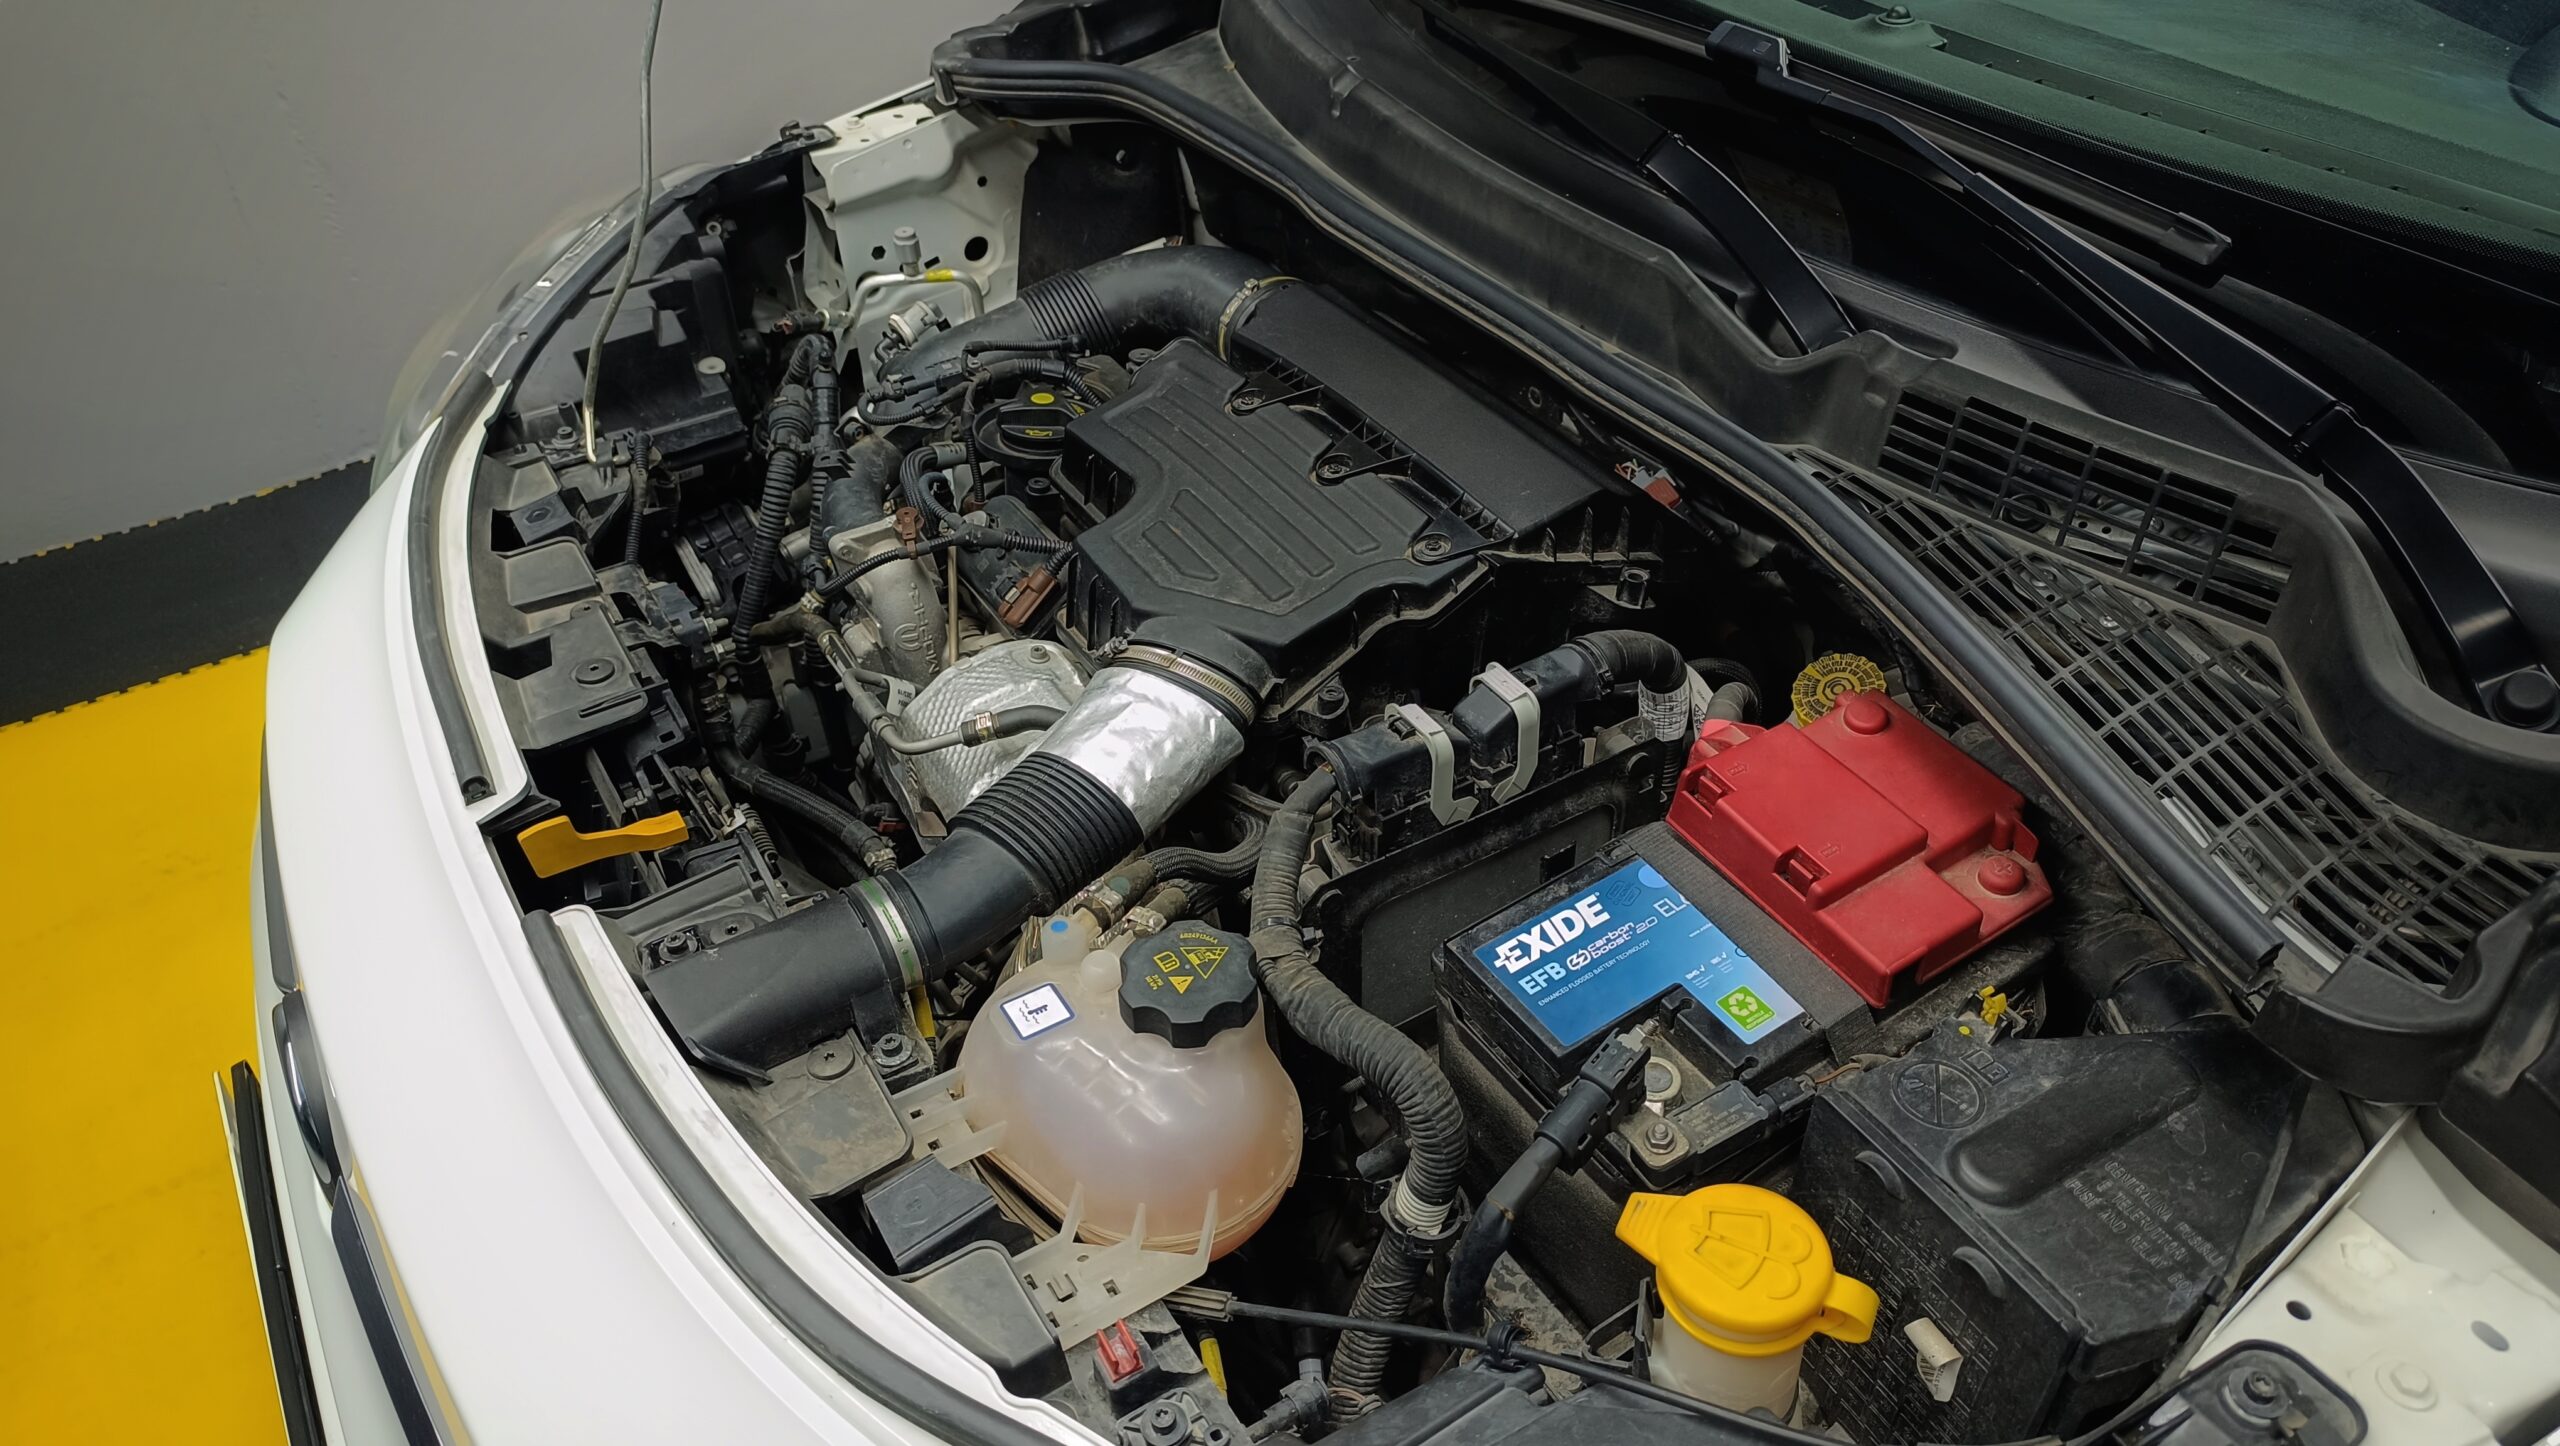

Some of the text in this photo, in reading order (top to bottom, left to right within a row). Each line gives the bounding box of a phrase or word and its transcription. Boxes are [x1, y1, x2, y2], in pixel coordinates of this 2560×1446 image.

[1652, 893, 1691, 917] EL
[1493, 894, 1611, 974] EXIDE
[1587, 922, 1635, 951] carbon
[1591, 933, 1632, 959] boost
[1518, 962, 1567, 996] EFB
[1538, 939, 1651, 1007] ENHANCED FLOODED BATTERY TECHNOLOGY
[2104, 1161, 2175, 1222] CENTRALINA
[2063, 1178, 2101, 1209] FUSE
[2100, 1208, 2128, 1234] AND
[2127, 1233, 2166, 1269] RELAY
